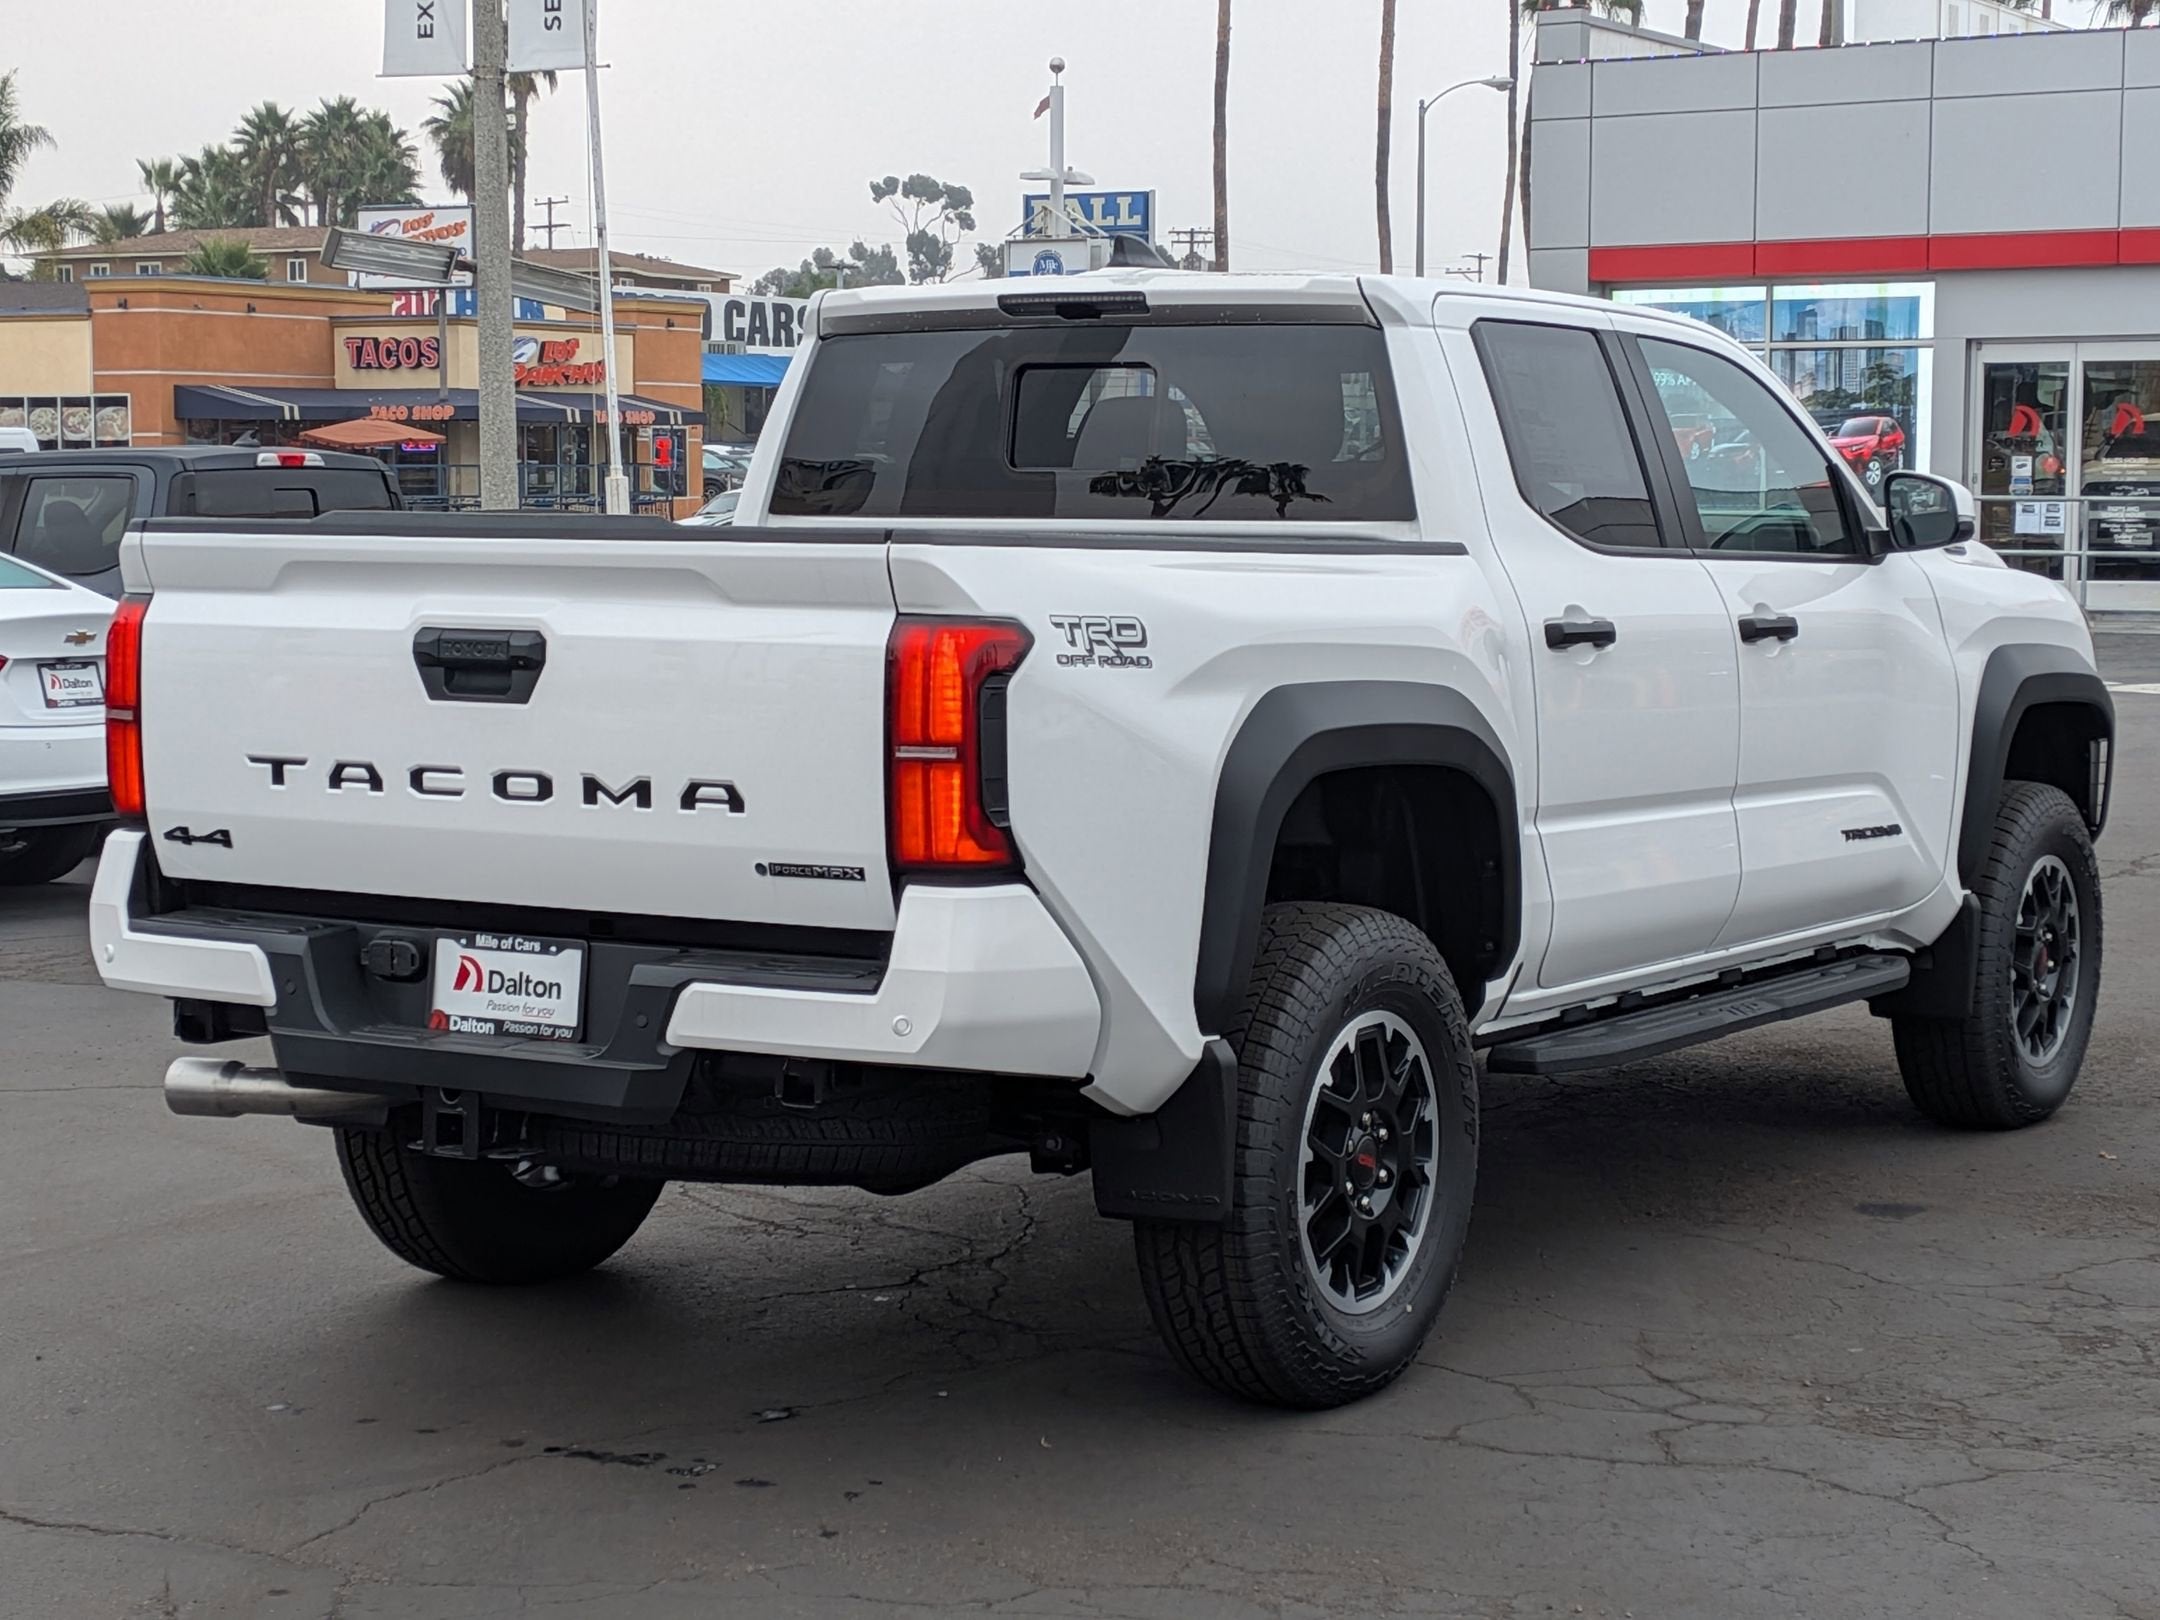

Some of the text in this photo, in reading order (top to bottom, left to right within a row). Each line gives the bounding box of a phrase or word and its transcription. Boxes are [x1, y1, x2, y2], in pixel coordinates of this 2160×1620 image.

[344, 336, 440, 370] TACOS
[539, 337, 581, 364] LOS
[371, 404, 455, 421] TACO SHOP
[595, 410, 656, 425] TAO SHOP
[1049, 614, 1148, 656] TRD
[1056, 654, 1153, 669] OFF ROAD
[62, 678, 93, 689] Dalton
[245, 753, 747, 816] TACOMA
[475, 934, 542, 953] Mile of Cars
[487, 970, 562, 1000] Dalton
[485, 999, 556, 1017] Passion for you
[449, 1015, 574, 1040] Dalton Passion for you
